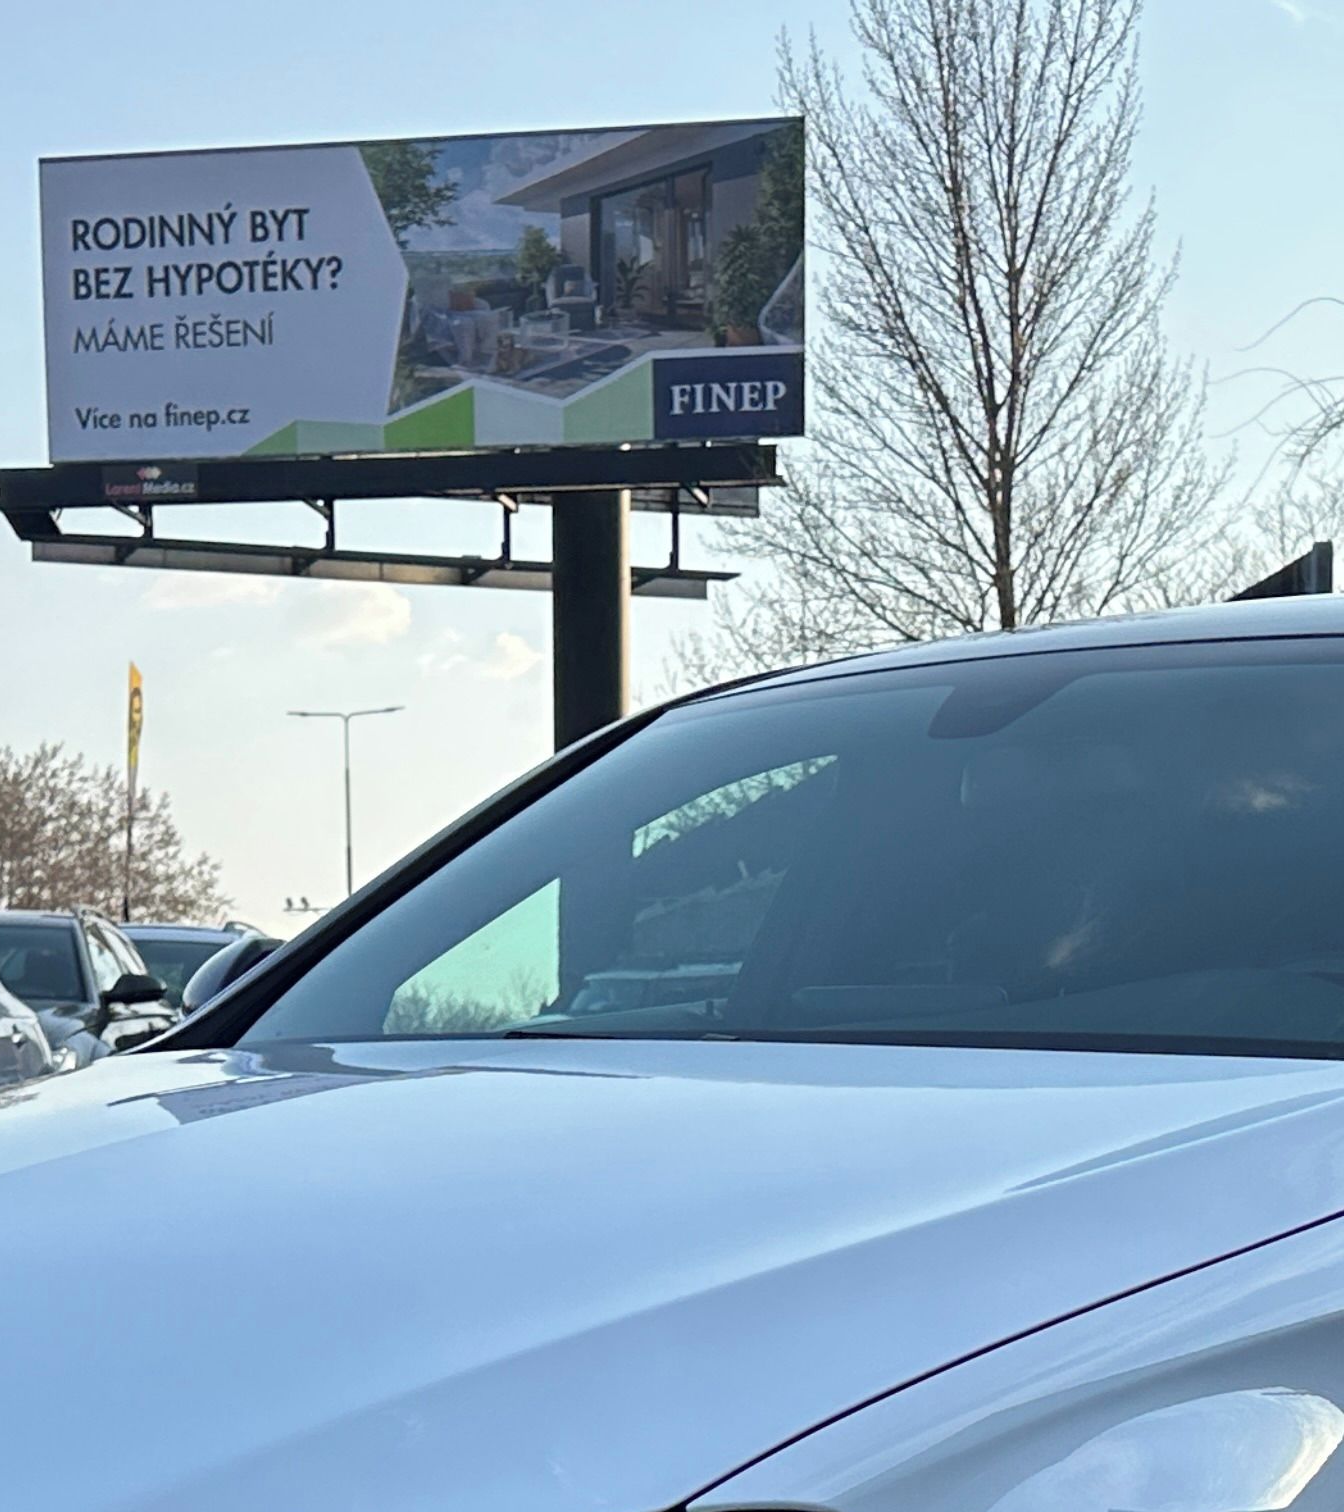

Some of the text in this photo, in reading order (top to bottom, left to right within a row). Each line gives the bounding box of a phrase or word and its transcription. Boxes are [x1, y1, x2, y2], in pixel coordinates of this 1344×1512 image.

[71, 202, 310, 251] RODINNÝ BYT
[73, 250, 343, 300] BEZ HYPOTÉKY?
[73, 311, 275, 353] MÁME ŘEŠENÍ
[75, 402, 251, 431] Více na finep.cz
[669, 380, 787, 416] FINEP
